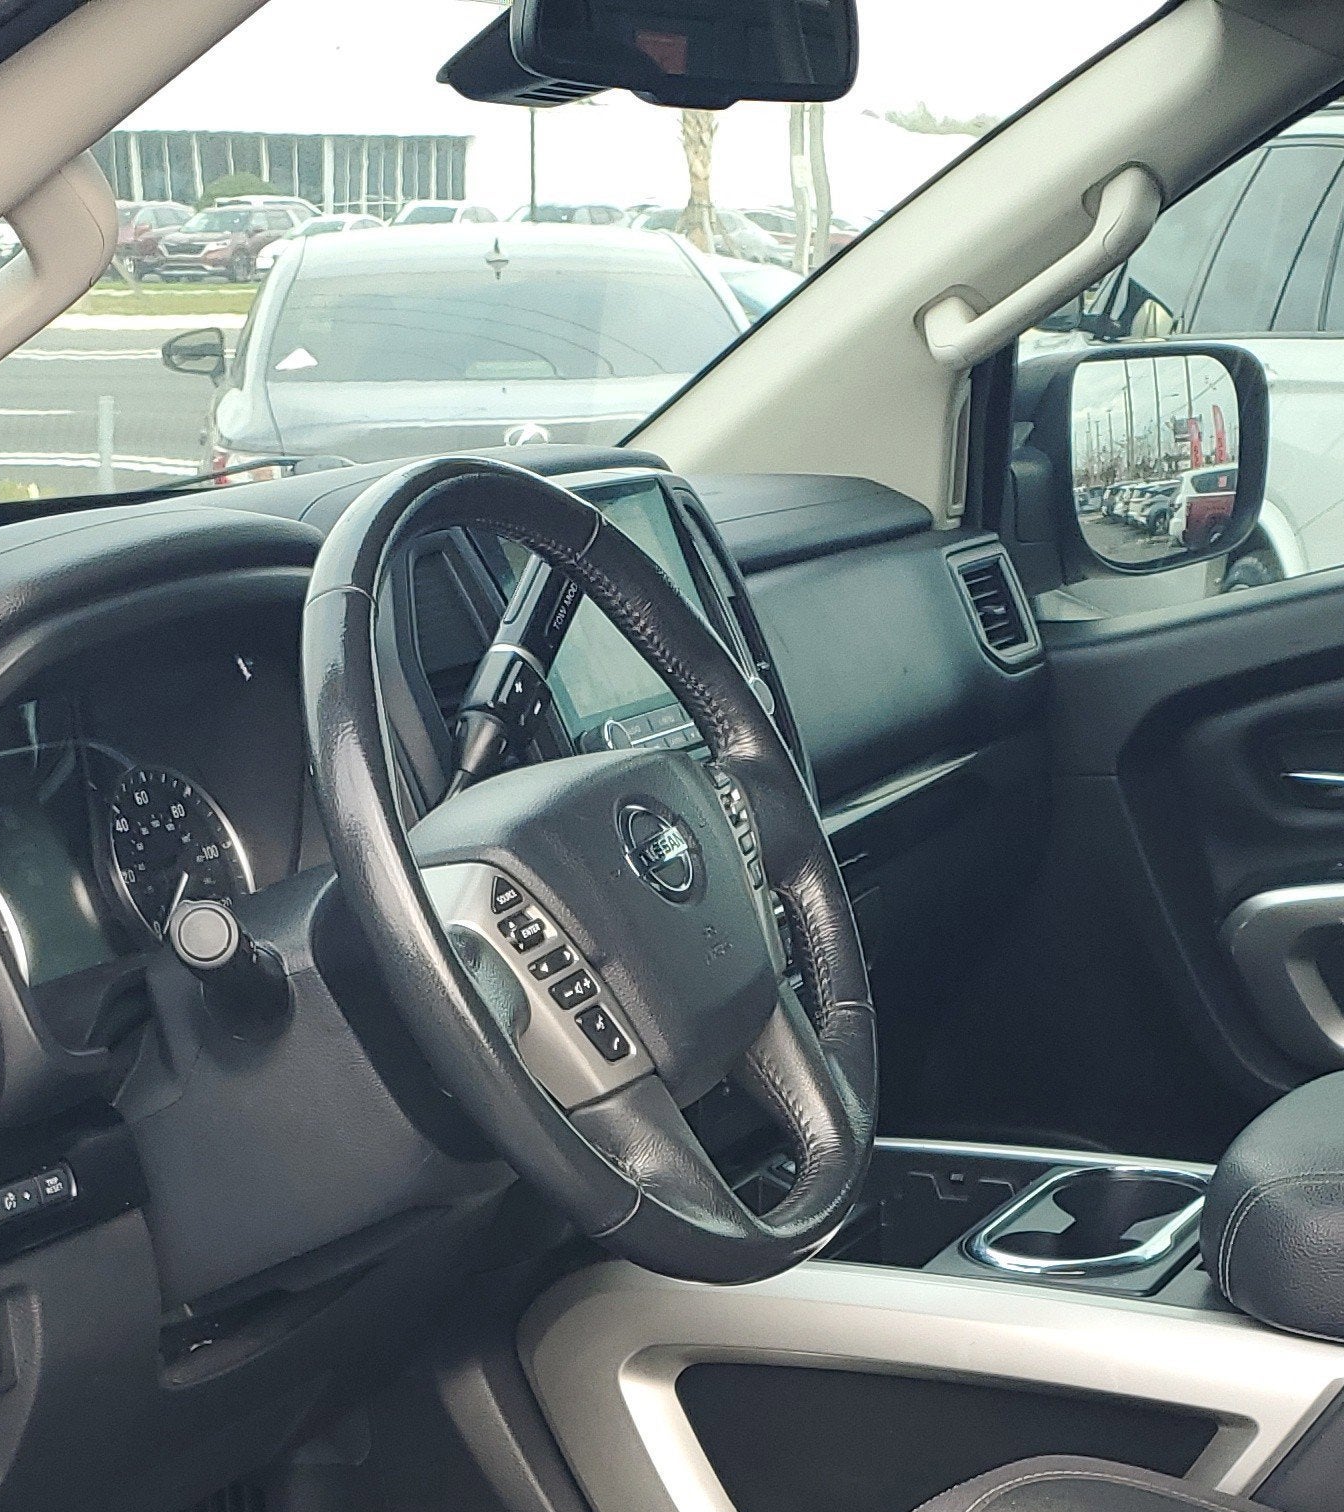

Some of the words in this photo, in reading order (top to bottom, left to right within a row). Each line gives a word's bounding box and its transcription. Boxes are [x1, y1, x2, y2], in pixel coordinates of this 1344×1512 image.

[563, 582, 578, 607] MOD
[134, 791, 149, 805] 60
[171, 804, 185, 818] 80
[116, 818, 129, 832] 40
[202, 845, 219, 859] 100
[640, 832, 685, 868] NISSAN
[496, 889, 518, 905] SOURCE
[521, 923, 542, 939] ENTER
